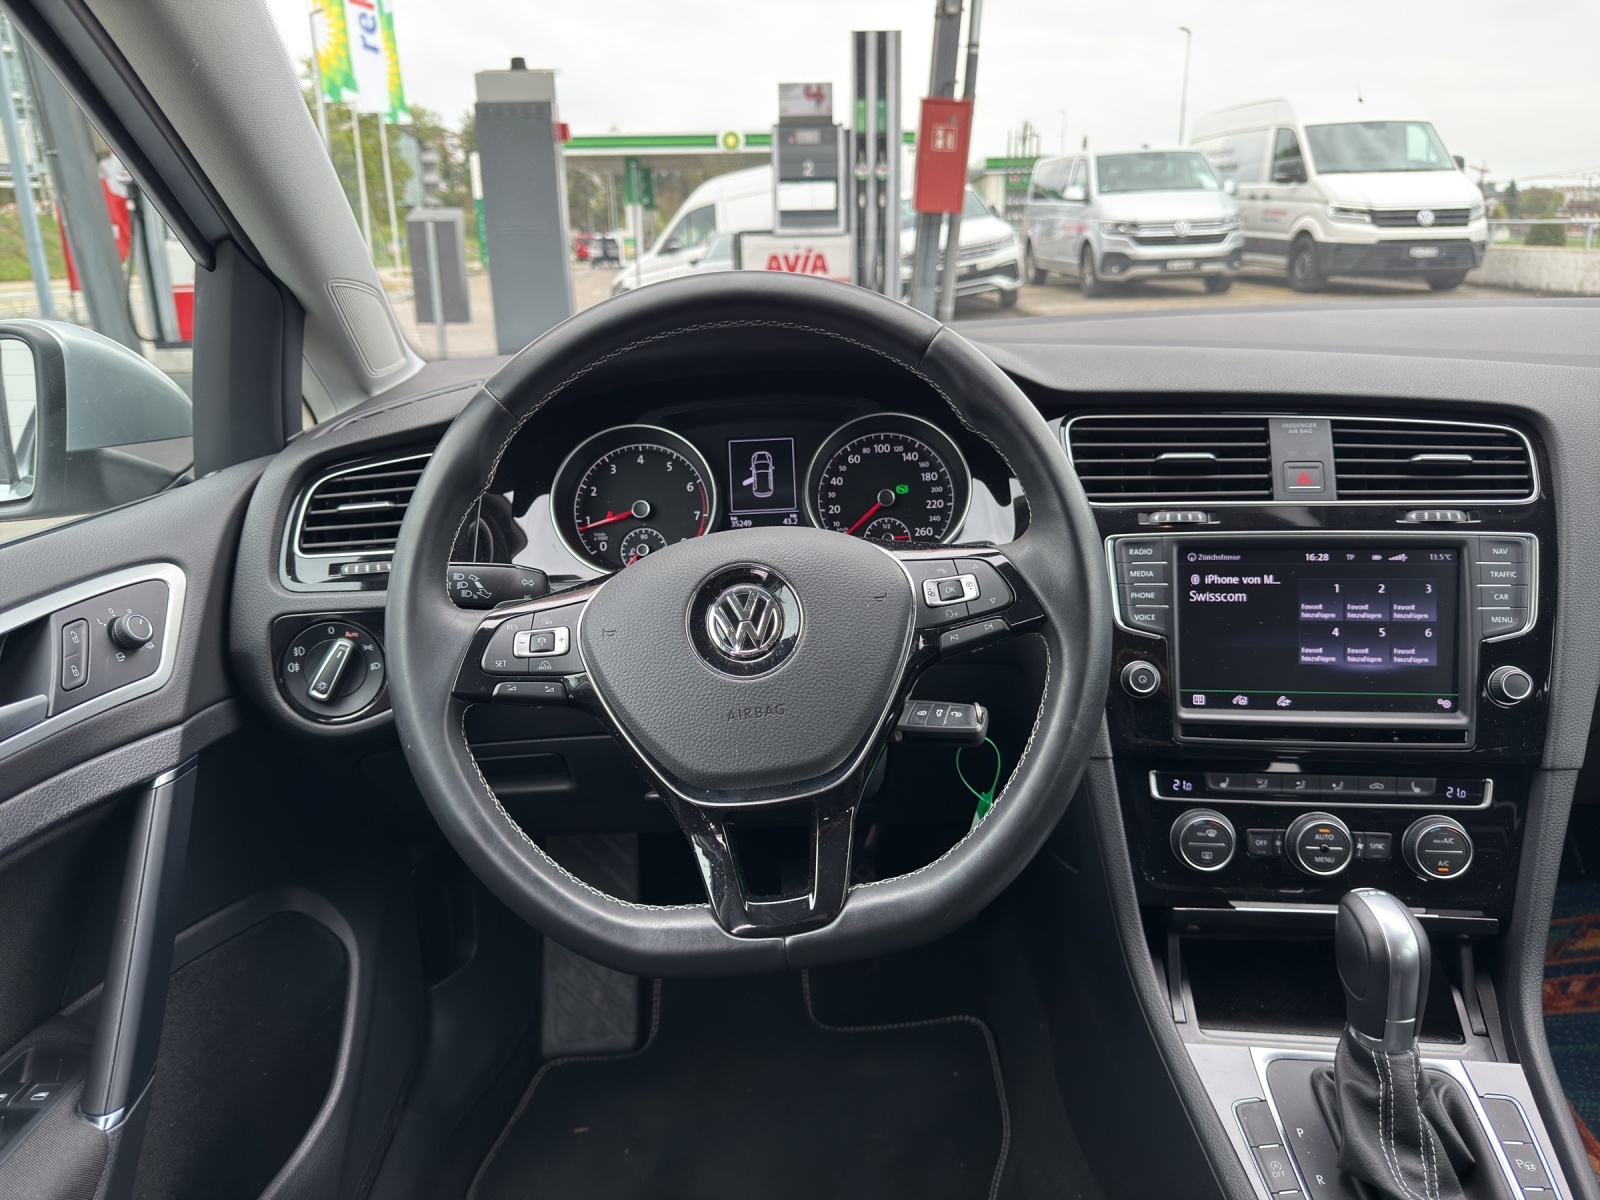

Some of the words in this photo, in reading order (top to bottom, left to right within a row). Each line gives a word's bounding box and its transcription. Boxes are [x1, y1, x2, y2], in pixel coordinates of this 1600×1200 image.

[802, 159, 815, 177] 2
[766, 247, 827, 275] AVIA
[873, 444, 891, 453] 100
[636, 455, 645, 464] 4
[847, 455, 861, 464] 60
[902, 452, 918, 461] 140
[610, 464, 617, 475] 3
[666, 462, 673, 472] 5
[920, 472, 938, 481] 180
[830, 477, 843, 486] 40
[590, 486, 598, 496] 2
[686, 482, 695, 492] 6
[926, 500, 944, 509] 220
[828, 505, 841, 514] 20
[585, 516, 591, 525] 1
[693, 511, 701, 521] 7
[730, 519, 752, 528] 35249
[782, 517, 798, 525] 43.2
[914, 527, 933, 537] 260
[599, 541, 608, 552] 0
[1197, 553, 1241, 561] Zürichstrasse
[1305, 553, 1330, 561] 16:28
[1204, 575, 1239, 584] iPhone
[945, 586, 956, 594] OK
[1334, 584, 1340, 593] 1
[1378, 584, 1385, 593] 2
[1425, 584, 1432, 593] 3
[1189, 591, 1247, 602] Swisscom
[328, 626, 335, 635] 0
[1332, 627, 1340, 637] 4
[1378, 628, 1386, 637] 5
[1424, 628, 1433, 637] 6
[727, 704, 786, 722] AIRBAG
[1314, 833, 1334, 841] AUTO
[1369, 842, 1385, 850] SYNC
[1296, 1127, 1304, 1138] P
[1515, 1158, 1524, 1169] P
[1315, 1174, 1326, 1185] R
